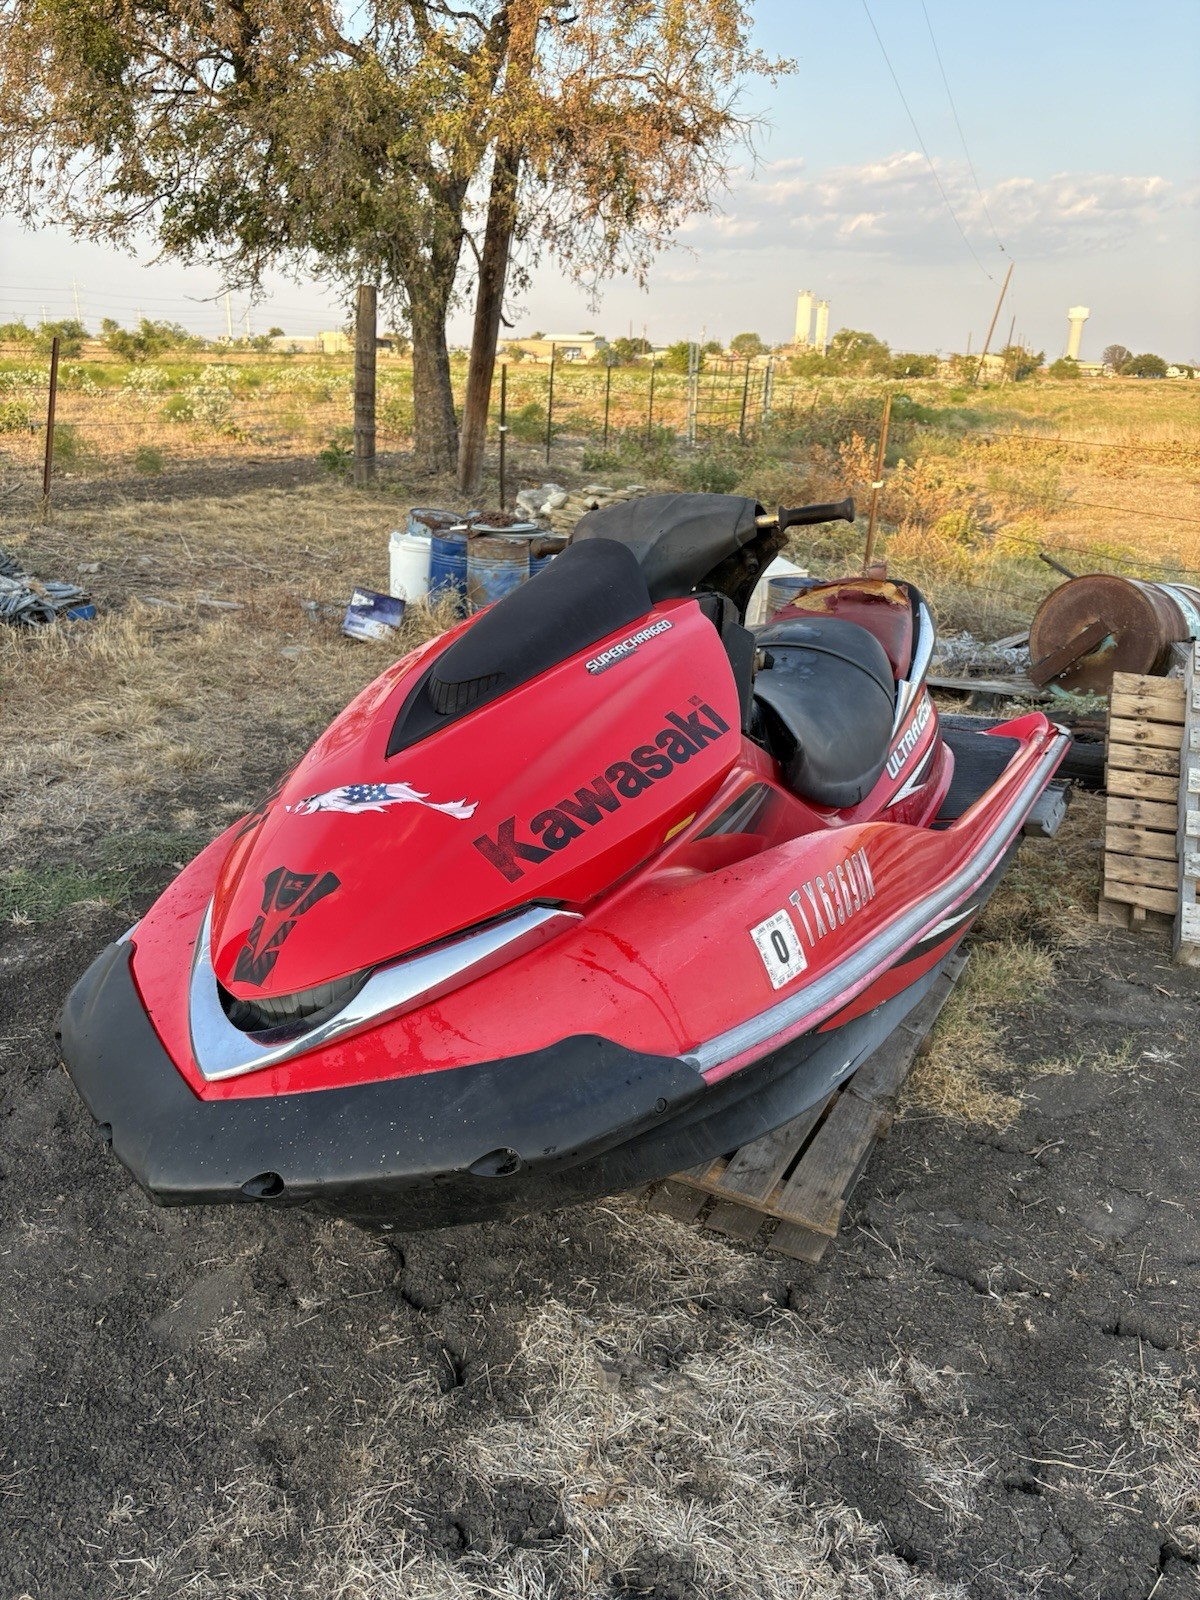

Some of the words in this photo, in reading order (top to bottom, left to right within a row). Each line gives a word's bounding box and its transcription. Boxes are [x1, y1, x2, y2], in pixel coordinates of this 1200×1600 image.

[586, 619, 673, 673] SUPERCHARGED
[472, 695, 731, 884] Kawasaki
[770, 929, 790, 964] 0
